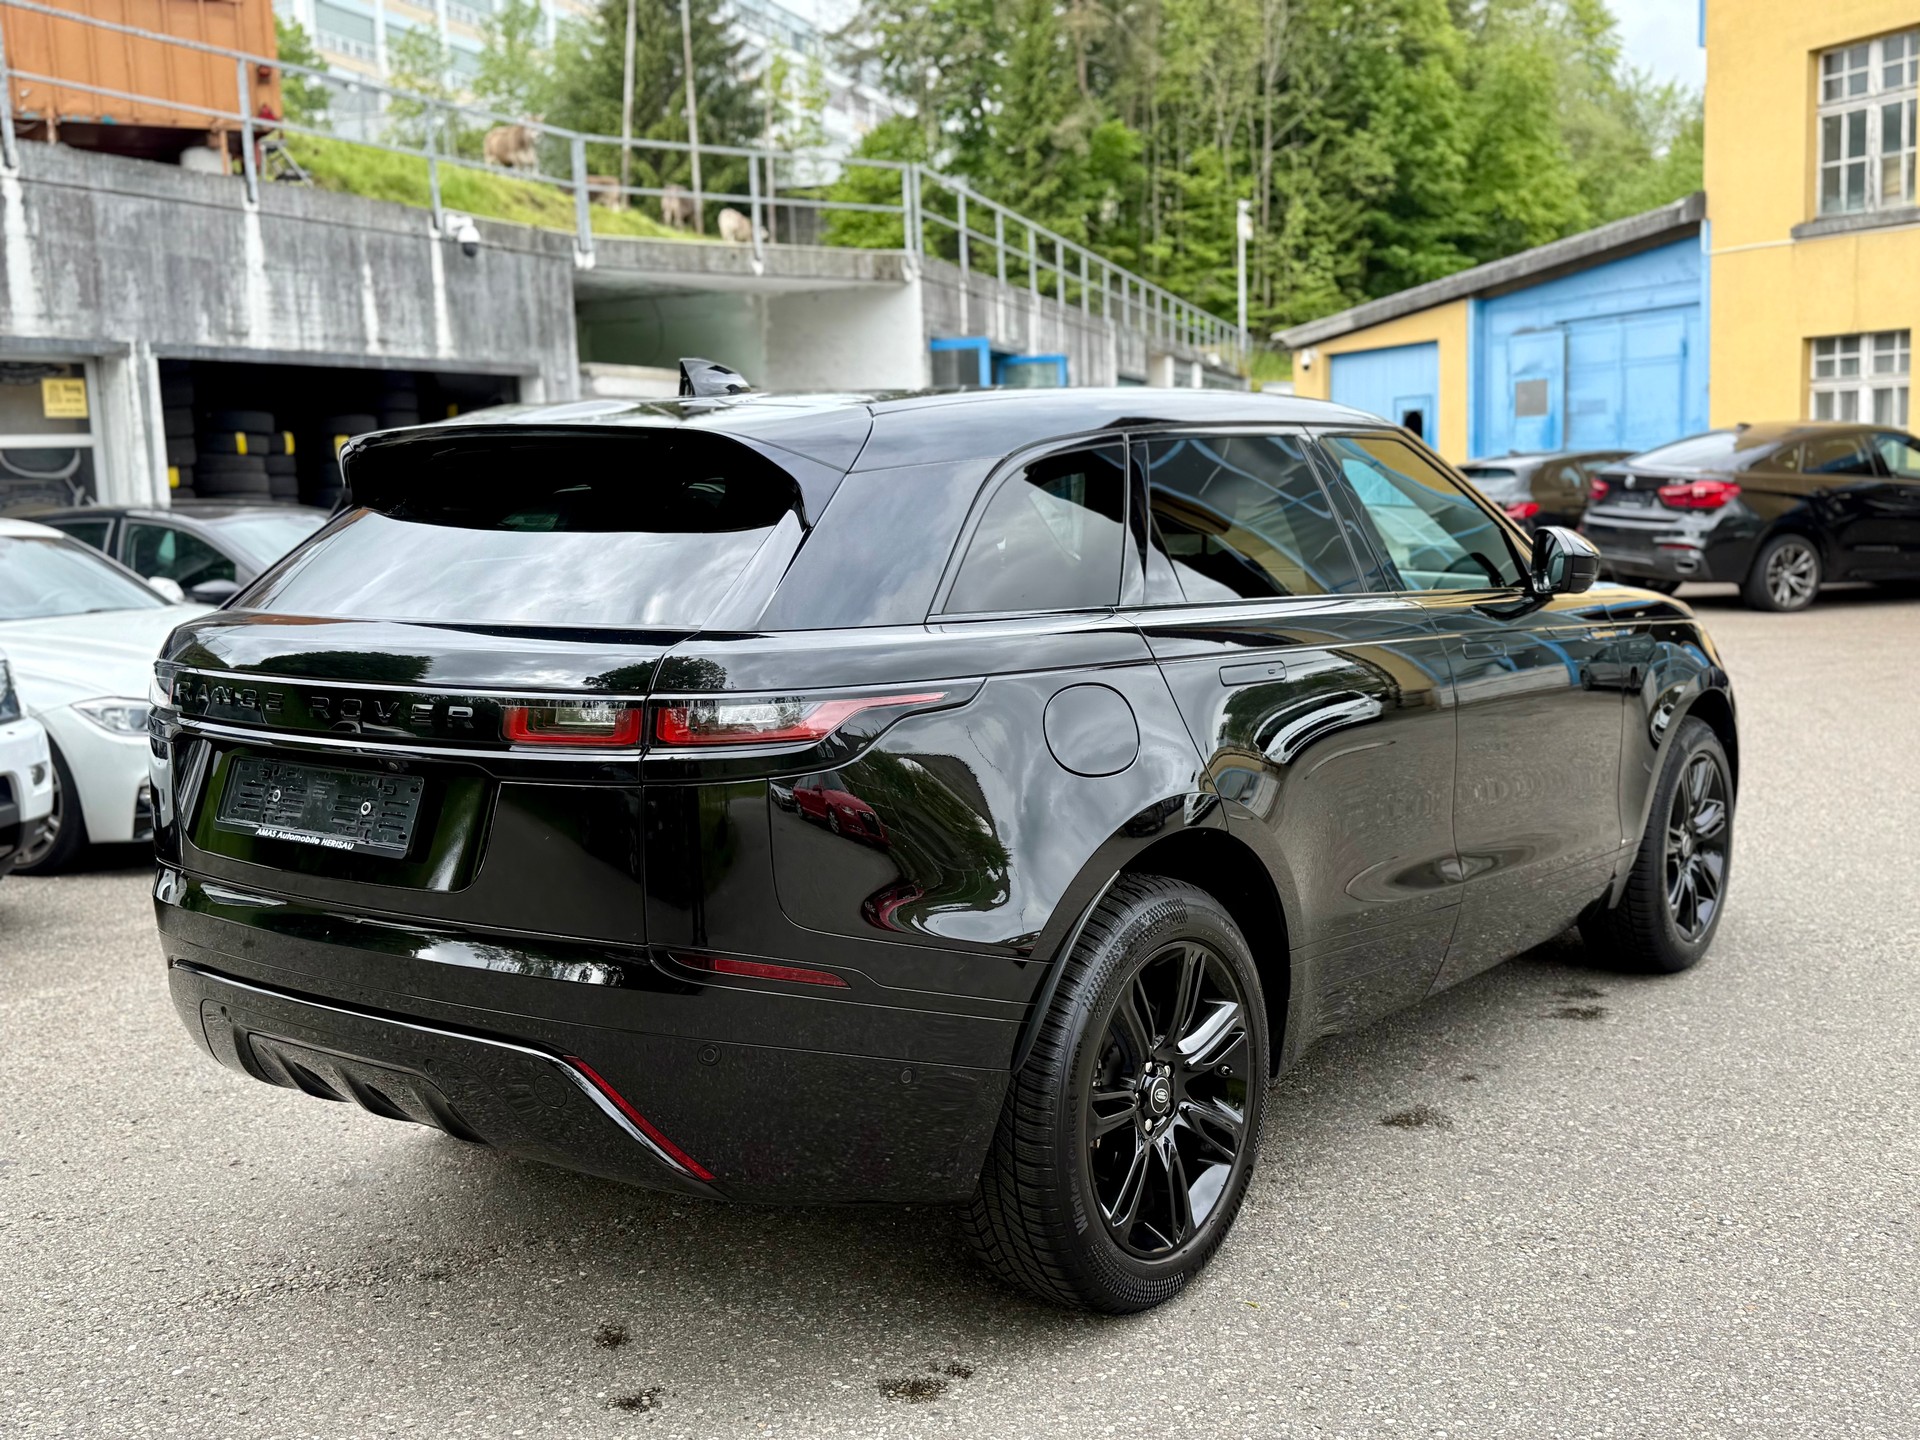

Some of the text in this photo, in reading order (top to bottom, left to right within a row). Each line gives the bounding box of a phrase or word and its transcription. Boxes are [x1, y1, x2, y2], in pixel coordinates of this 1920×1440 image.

[175, 681, 475, 729] RANGE ROVER
[255, 828, 355, 851] AMAS Automobile HERISAU
